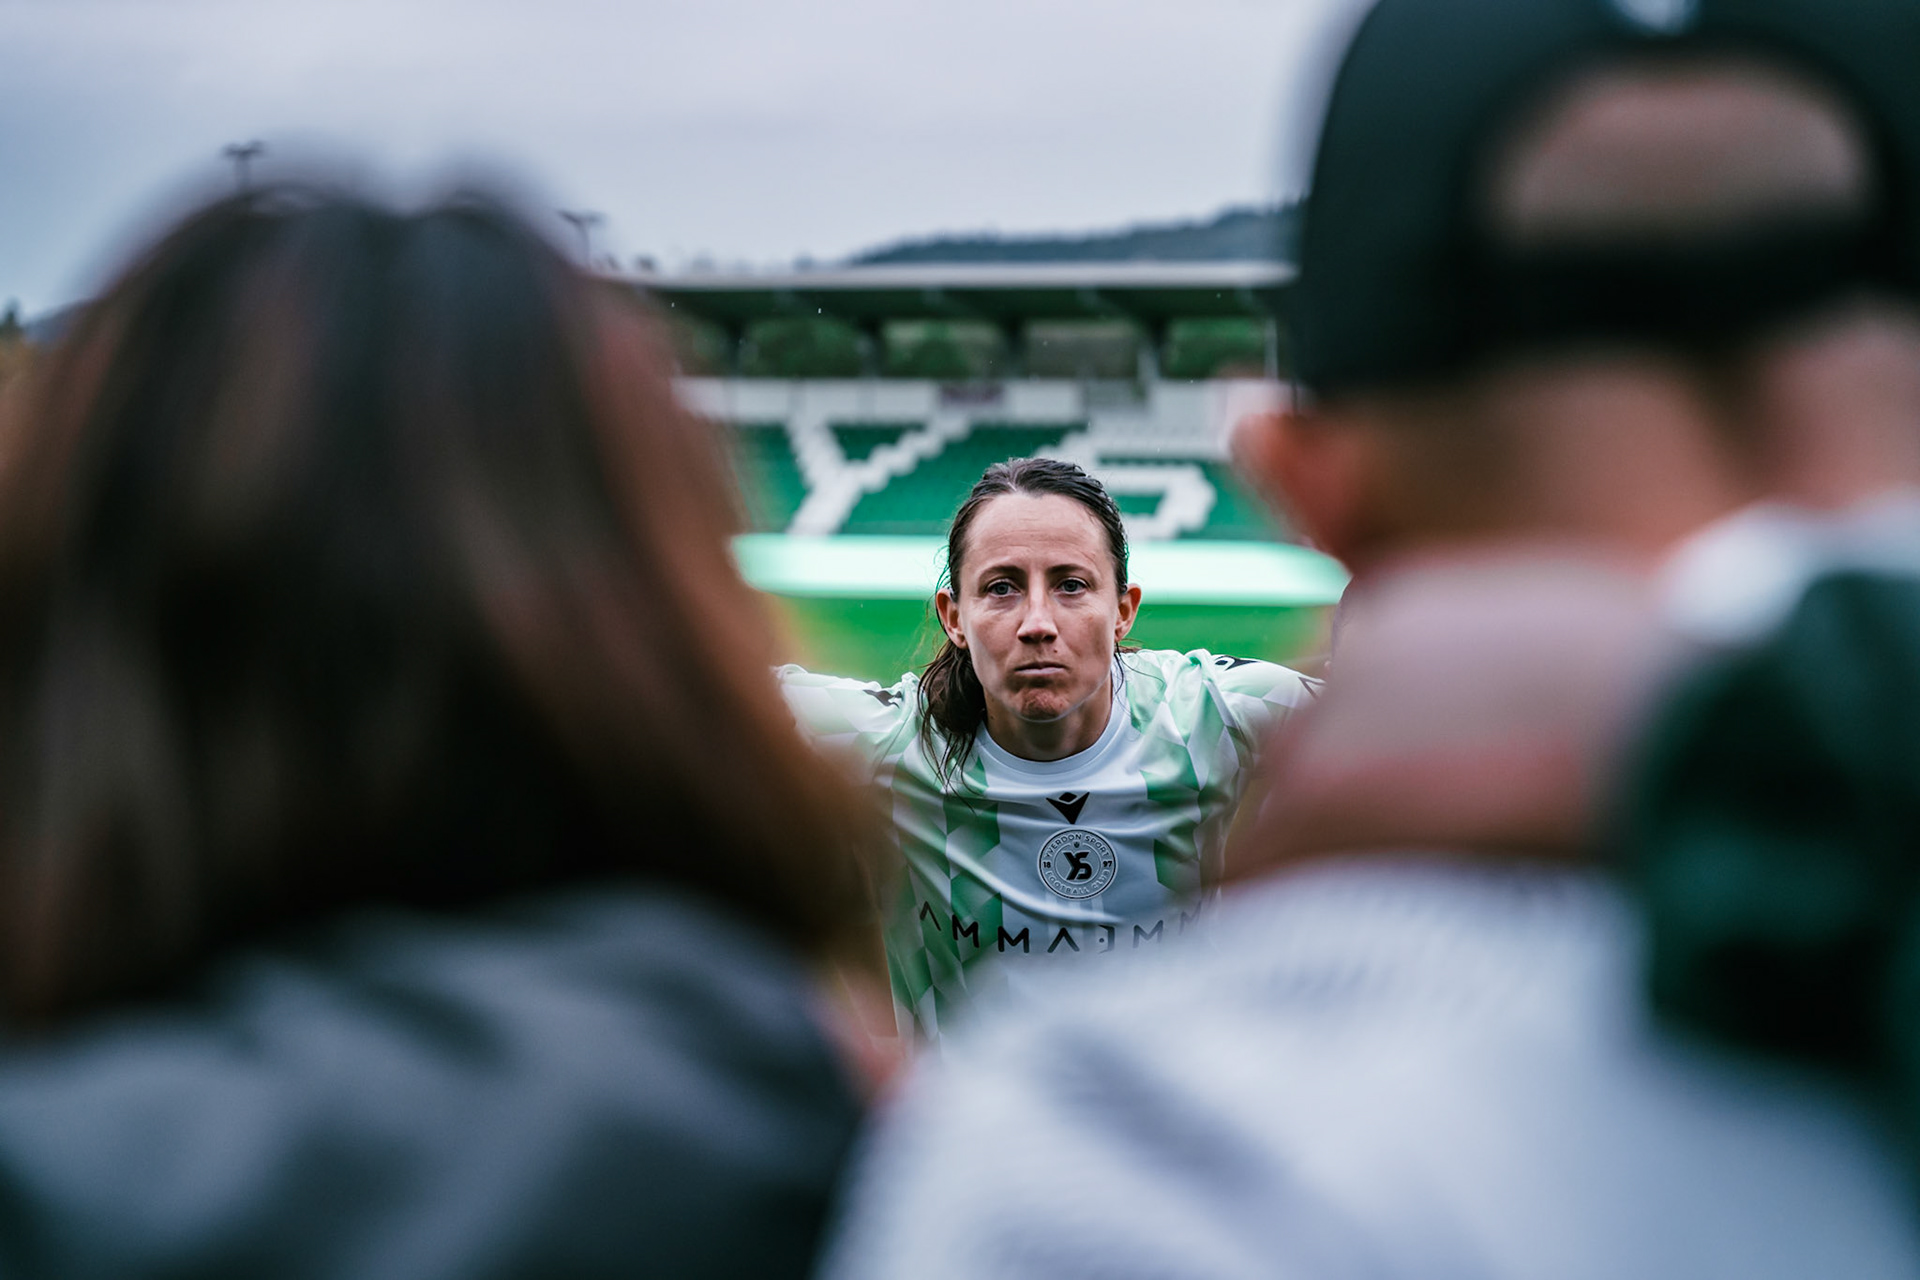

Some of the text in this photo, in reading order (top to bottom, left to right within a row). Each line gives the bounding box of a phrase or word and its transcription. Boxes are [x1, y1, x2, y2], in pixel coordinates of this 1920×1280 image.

[1045, 834, 1110, 858] YVERDON SPORT
[1103, 860, 1113, 868] 97
[1046, 869, 1111, 894] FOOTBALL CLUB
